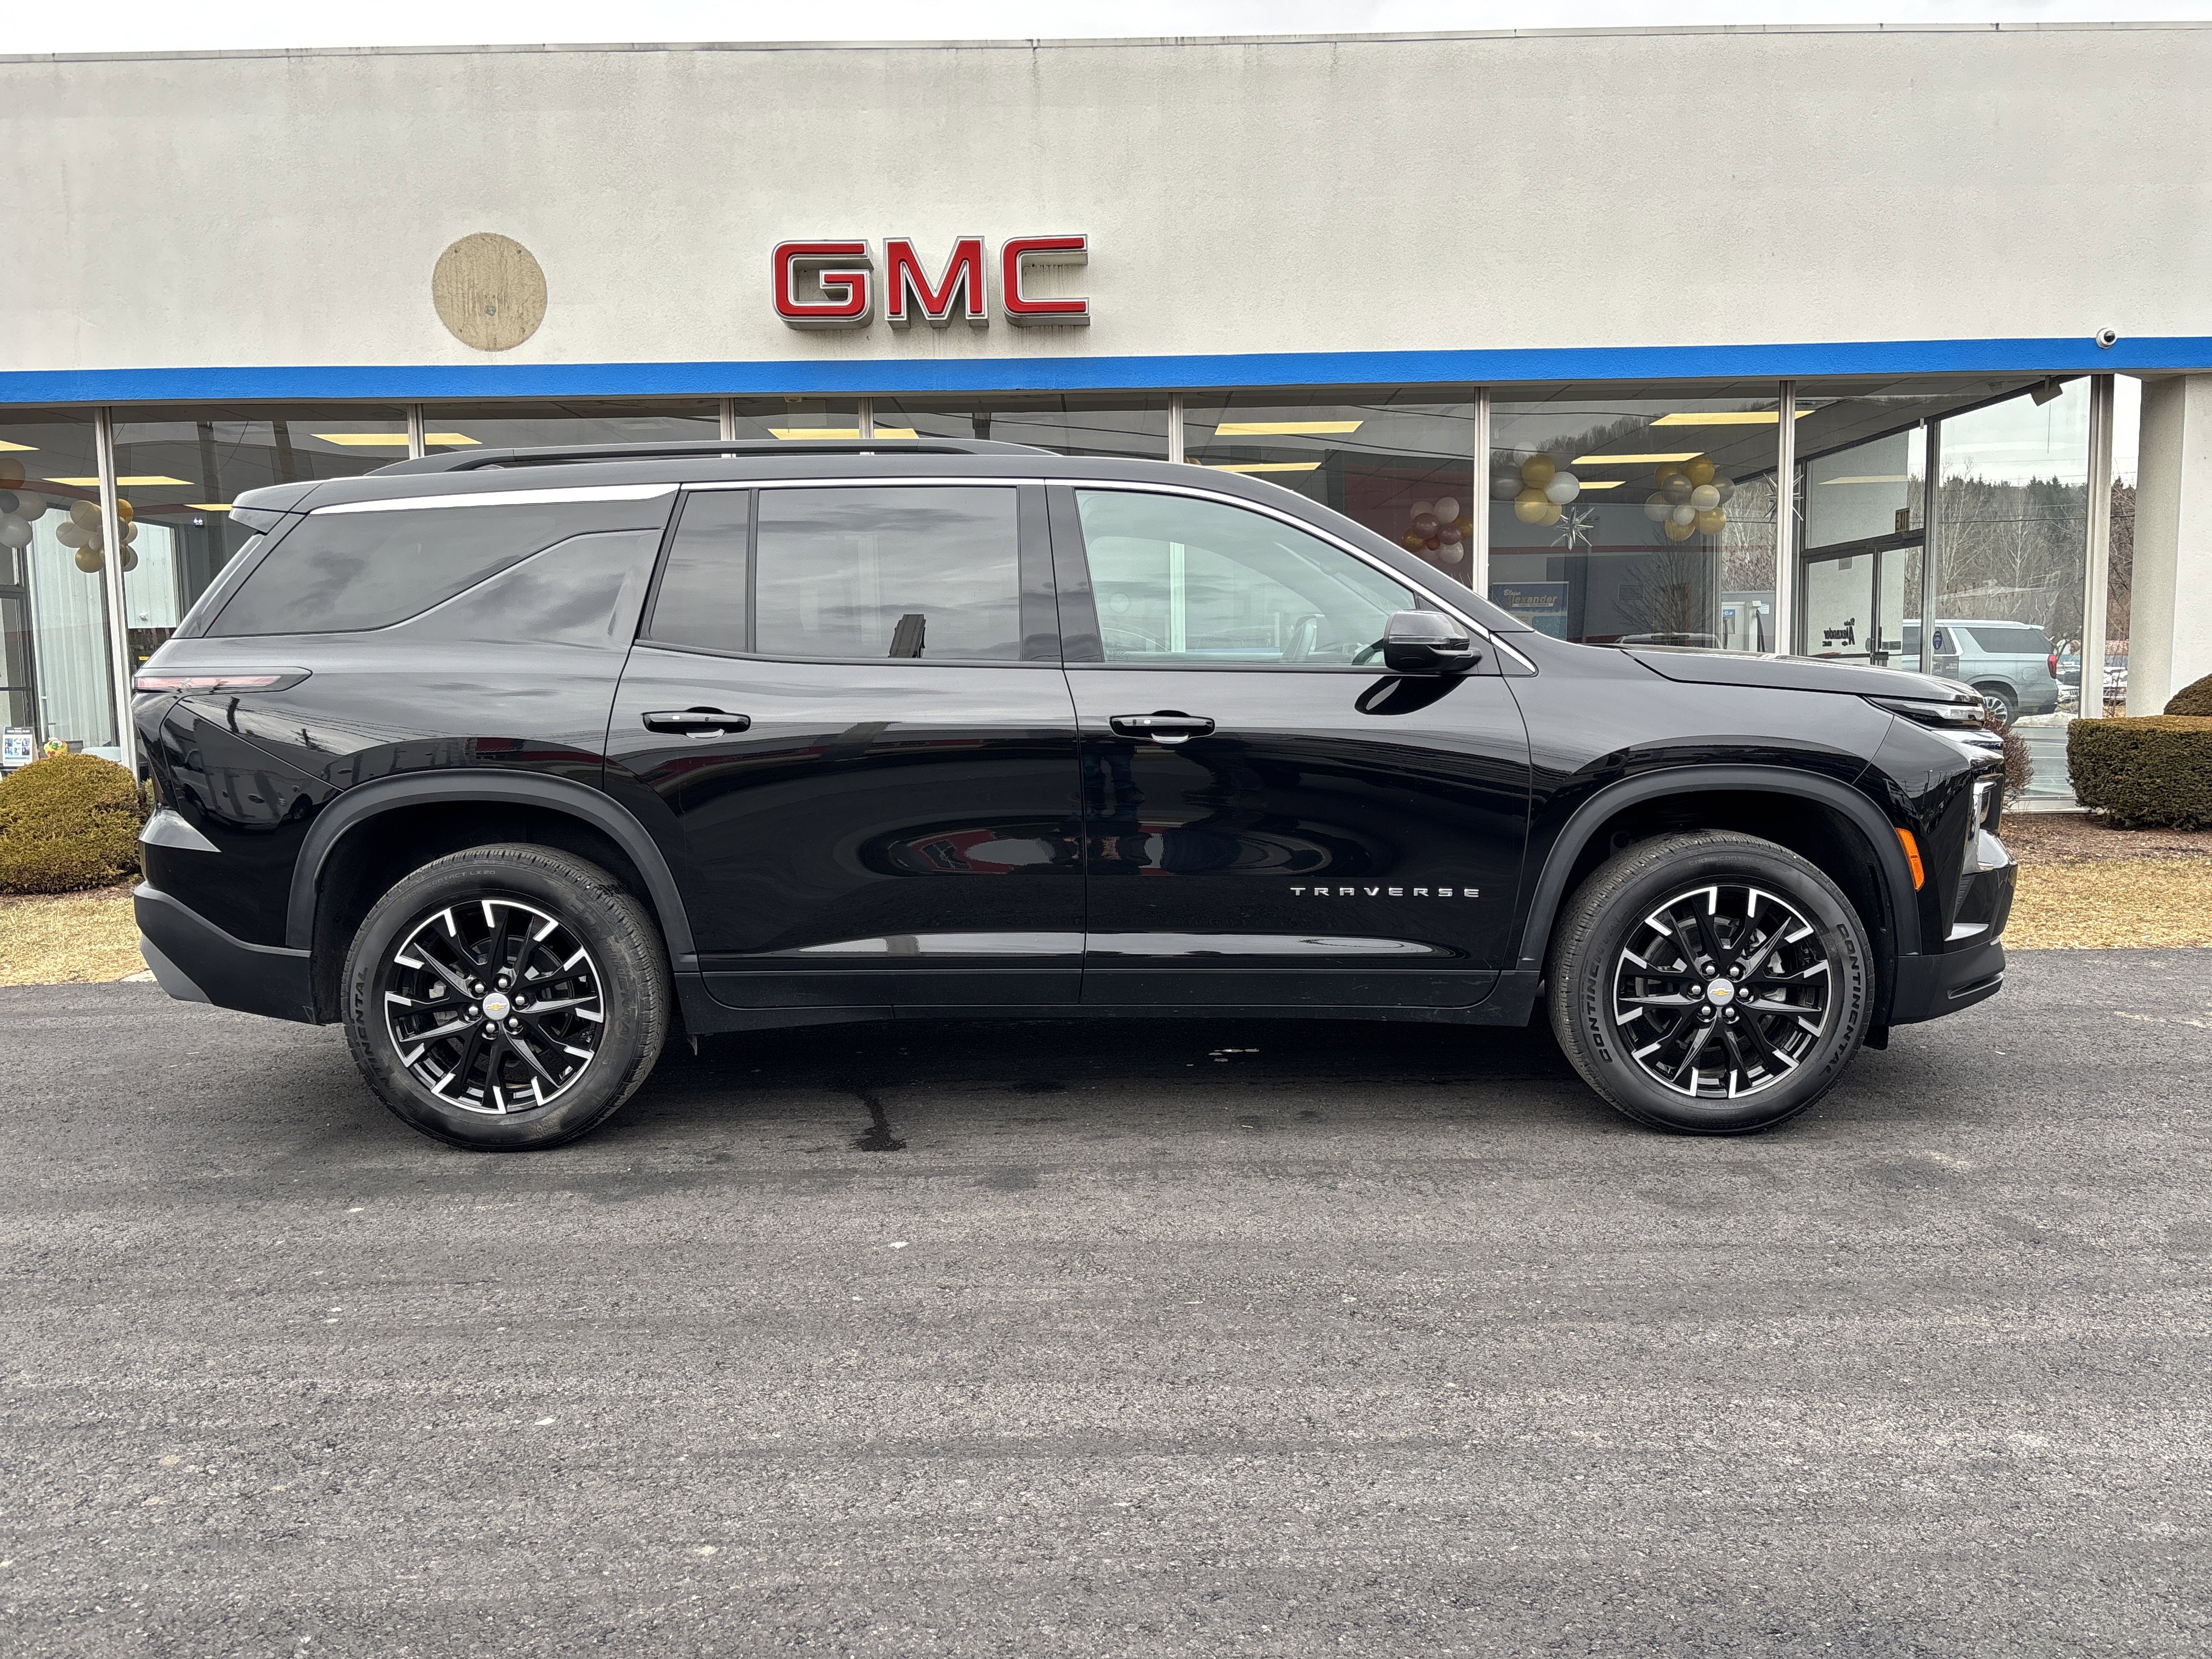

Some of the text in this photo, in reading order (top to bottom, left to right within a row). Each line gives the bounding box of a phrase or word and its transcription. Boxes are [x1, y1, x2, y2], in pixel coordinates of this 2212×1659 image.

[771, 234, 1090, 328] GMC
[1896, 510, 1909, 531] EXIT
[1290, 887, 1480, 898] TRAVERSE
[354, 967, 420, 1114] CONTINENTAL
[1587, 909, 1629, 1063] CONTINENTAL
[1819, 923, 1861, 1076] CONTINENTAL
